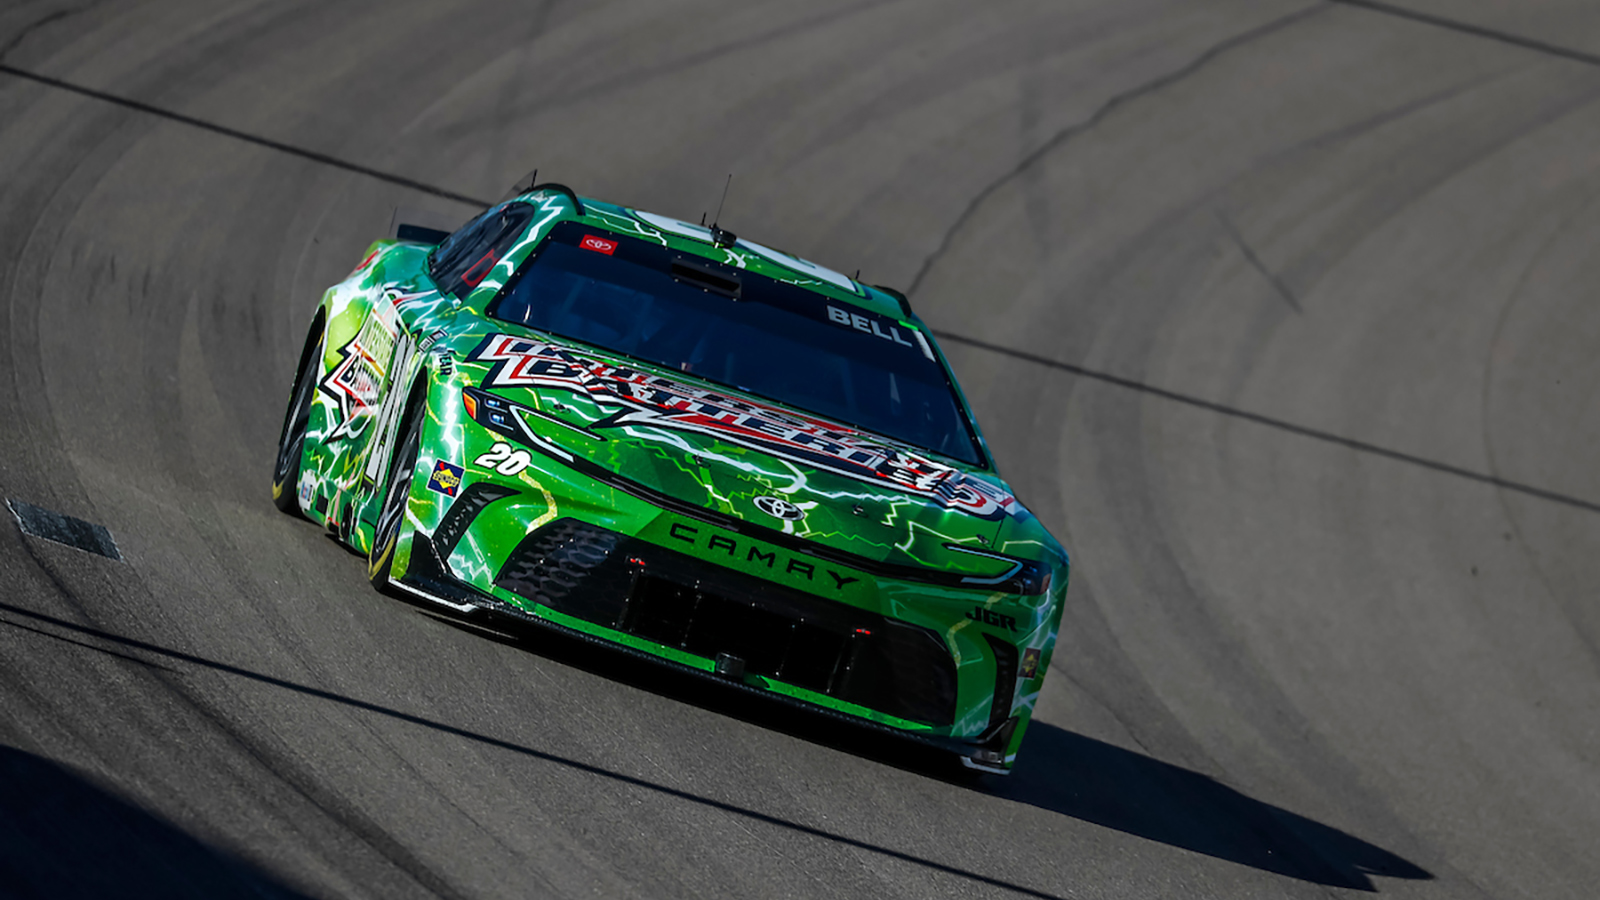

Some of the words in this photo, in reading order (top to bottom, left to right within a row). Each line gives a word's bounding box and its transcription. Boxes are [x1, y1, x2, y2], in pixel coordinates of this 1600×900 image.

[827, 305, 913, 348] BELL
[473, 441, 533, 476] 20
[670, 523, 860, 590] CAMRY
[965, 605, 1017, 632] JGR
